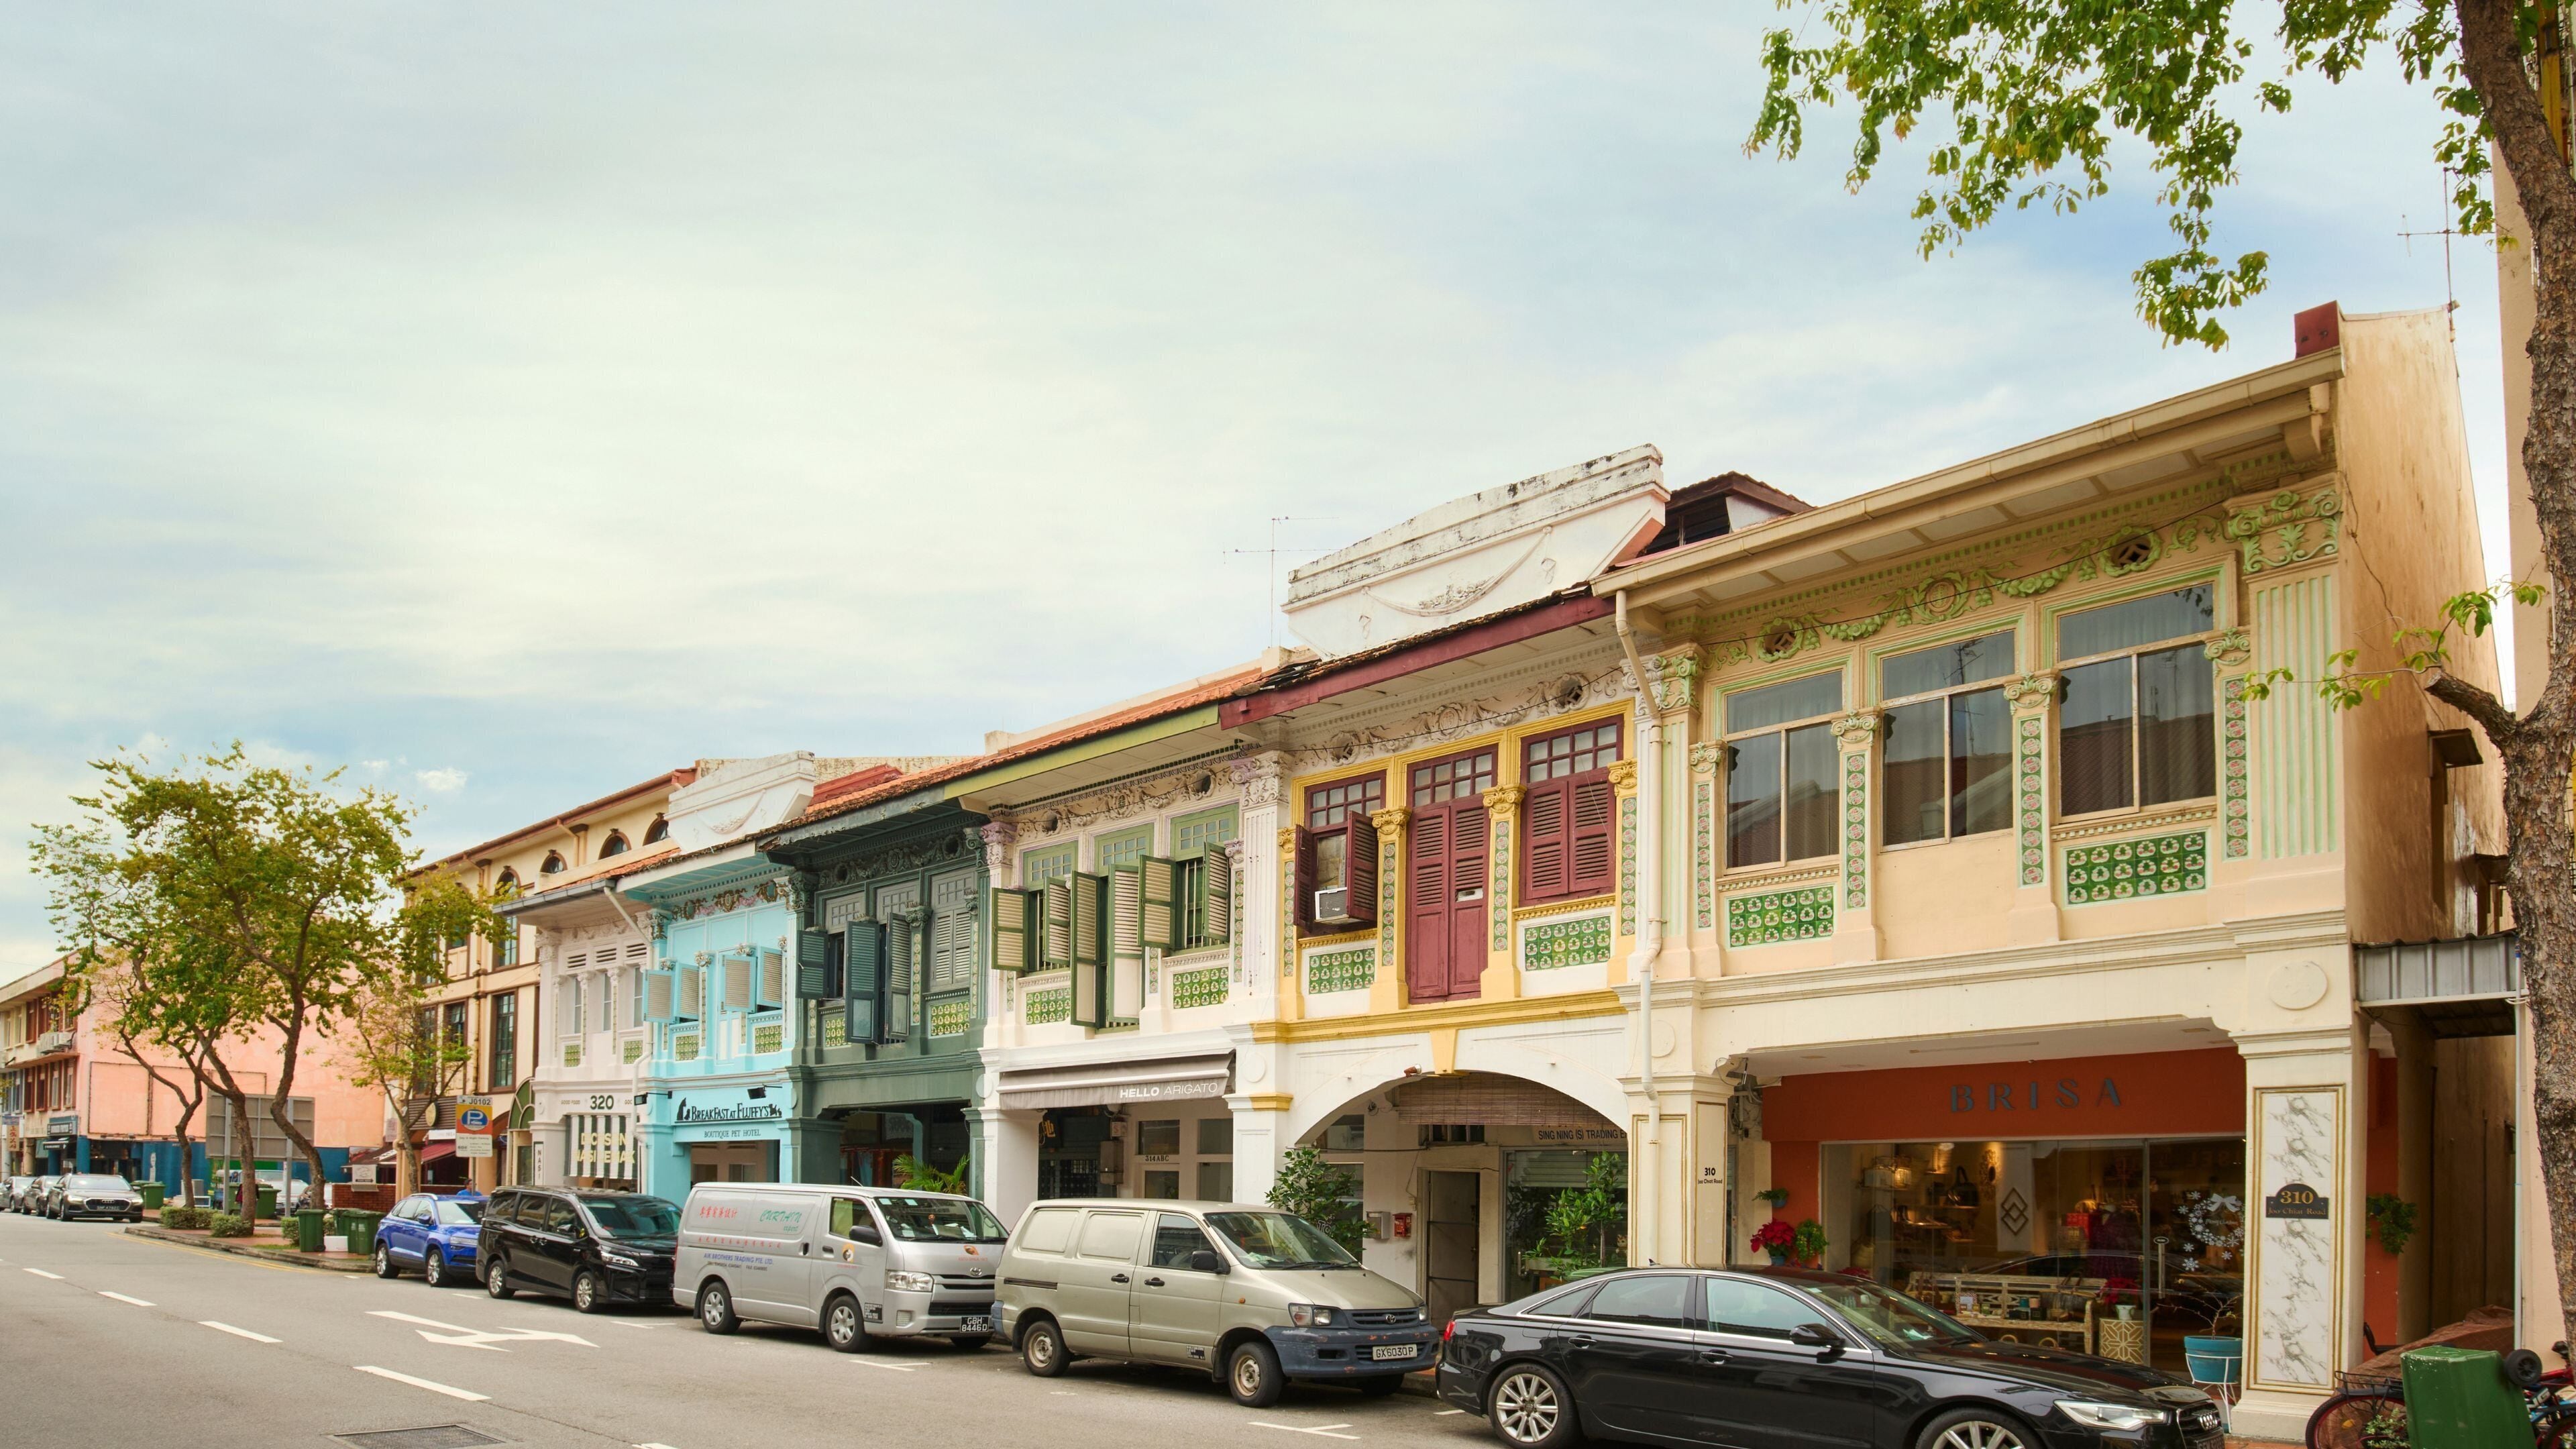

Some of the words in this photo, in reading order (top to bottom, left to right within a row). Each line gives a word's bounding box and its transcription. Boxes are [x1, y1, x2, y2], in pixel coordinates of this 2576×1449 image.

[1120, 1087, 1160, 1099] HELLO
[1164, 1083, 1218, 1095] ARIGATO
[1950, 1077, 2121, 1113] BRISA
[590, 1095, 614, 1110] 320
[581, 1132, 627, 1146] DCSN
[704, 1130, 729, 1139] BOUTIQUE
[731, 1130, 740, 1138] PET
[1538, 1130, 1555, 1140] SING
[1556, 1130, 1574, 1140] NING
[1575, 1129, 1584, 1140] (S)
[1586, 1130, 1618, 1139] TRADING
[600, 1150, 636, 1164] EAK
[1705, 1167, 1716, 1176] 310
[2280, 1190, 2314, 1205] 310
[712, 1253, 733, 1261] BROTHERS
[734, 1255, 755, 1263] TRADING
[967, 1317, 983, 1325] GBH
[961, 1324, 987, 1332] 8446D
[1376, 1346, 1413, 1358] GX6030P
